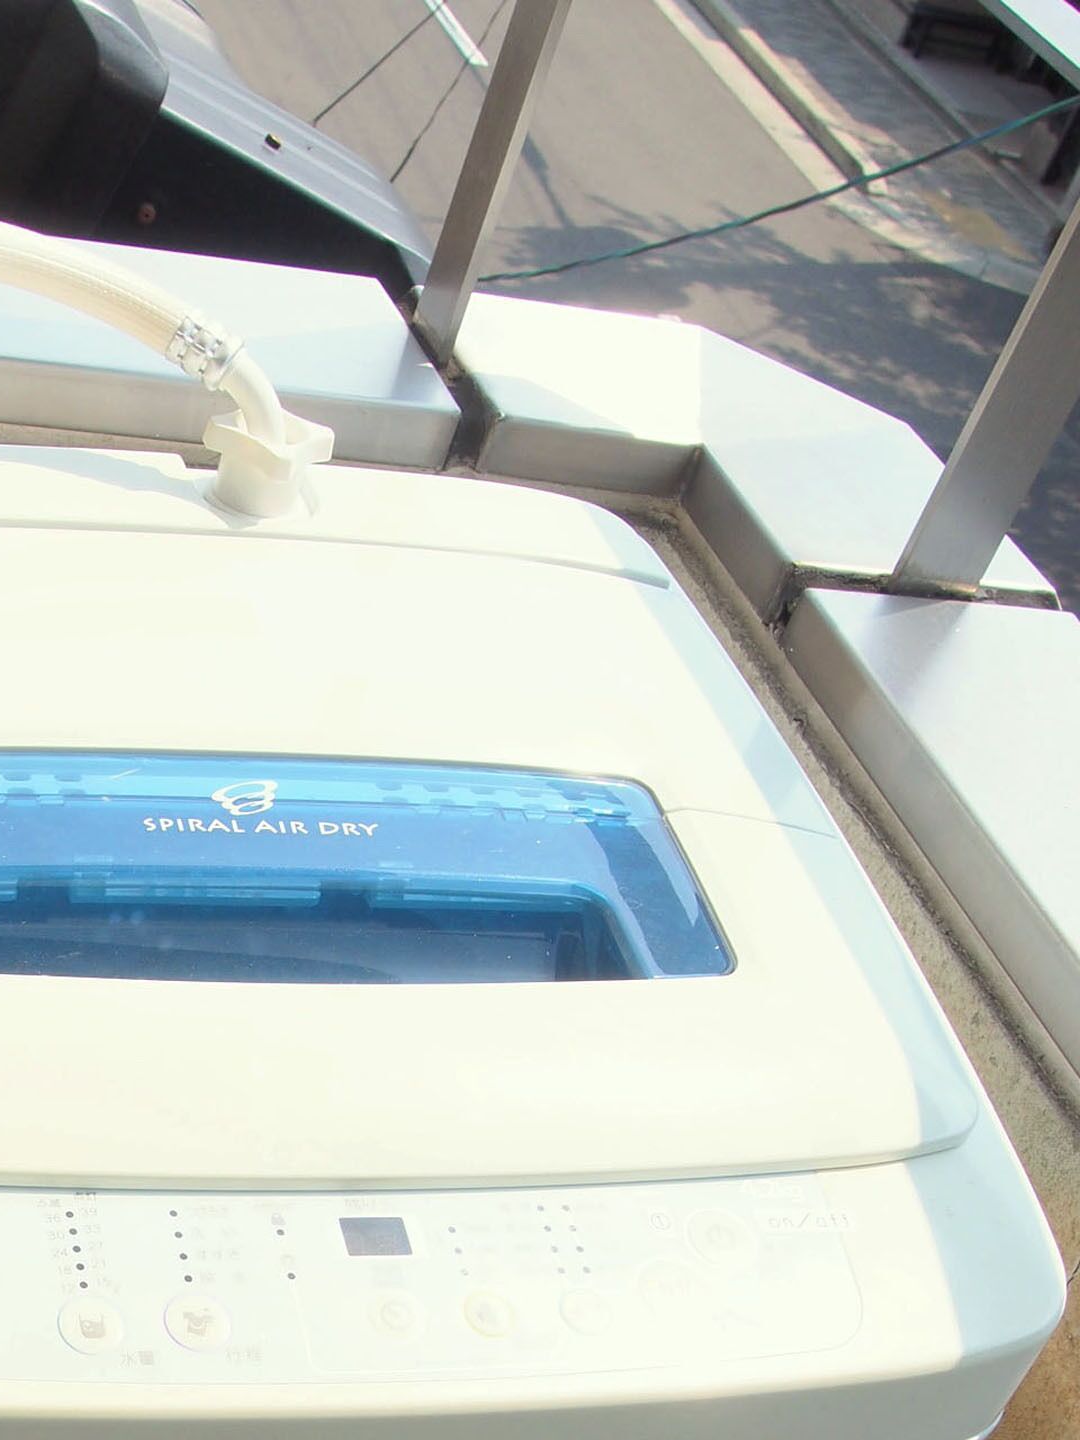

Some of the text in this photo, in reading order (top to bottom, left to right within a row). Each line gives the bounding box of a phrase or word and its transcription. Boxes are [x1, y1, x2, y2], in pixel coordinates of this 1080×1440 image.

[143, 817, 379, 837] SPIRAL AIR DRY
